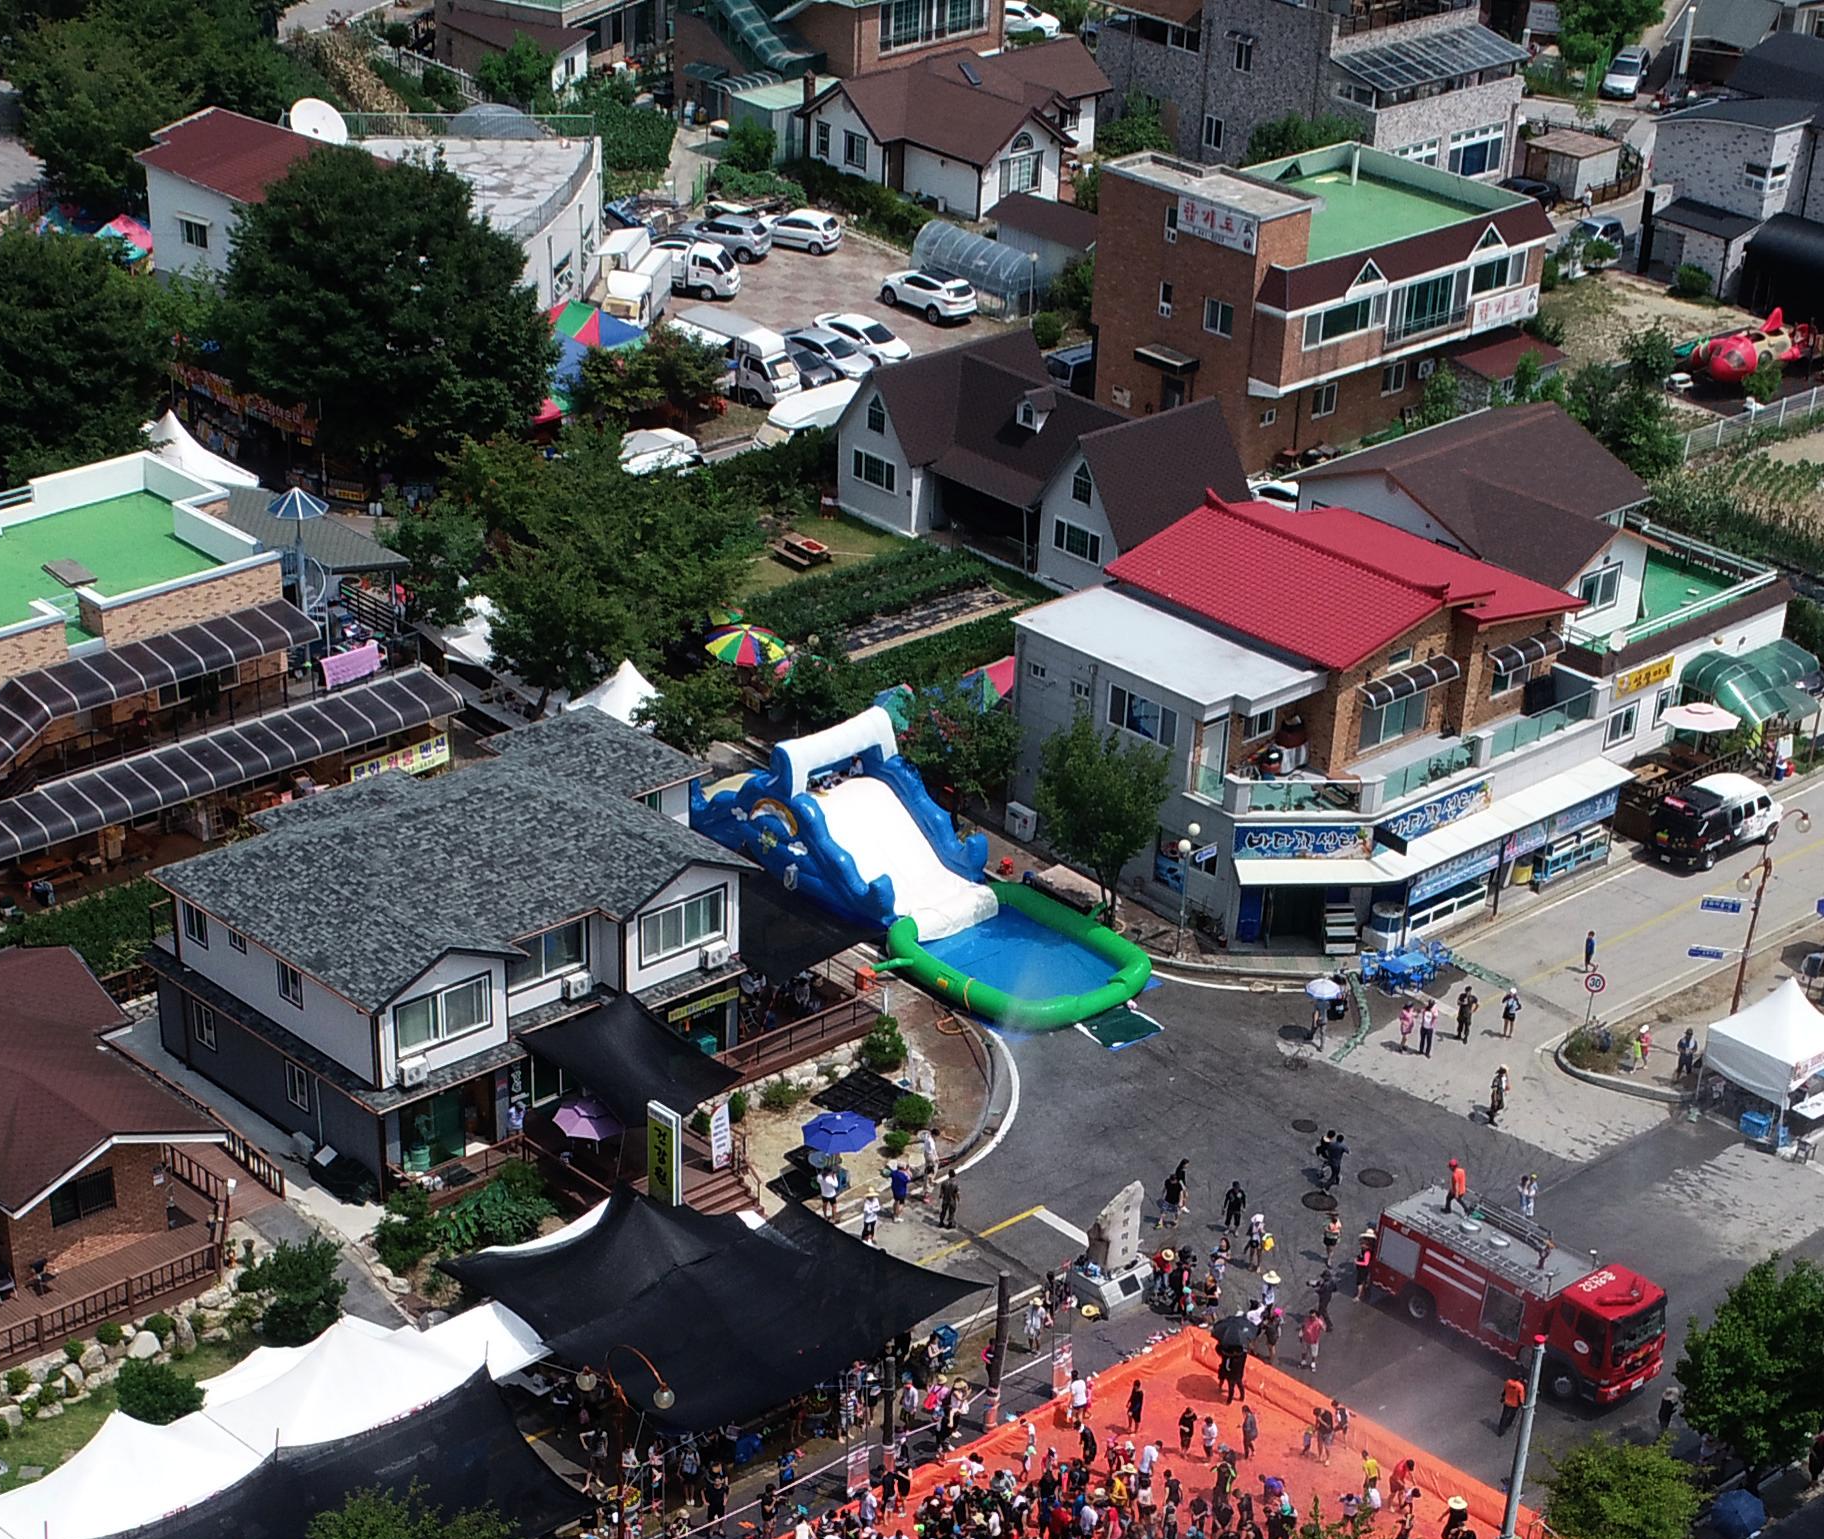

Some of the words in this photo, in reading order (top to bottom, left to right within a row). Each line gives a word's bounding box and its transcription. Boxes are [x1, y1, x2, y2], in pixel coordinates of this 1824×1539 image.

[1316, 831, 1361, 851] 센터
[1589, 977, 1602, 988] 30
[653, 1125, 668, 1187] 건강원
